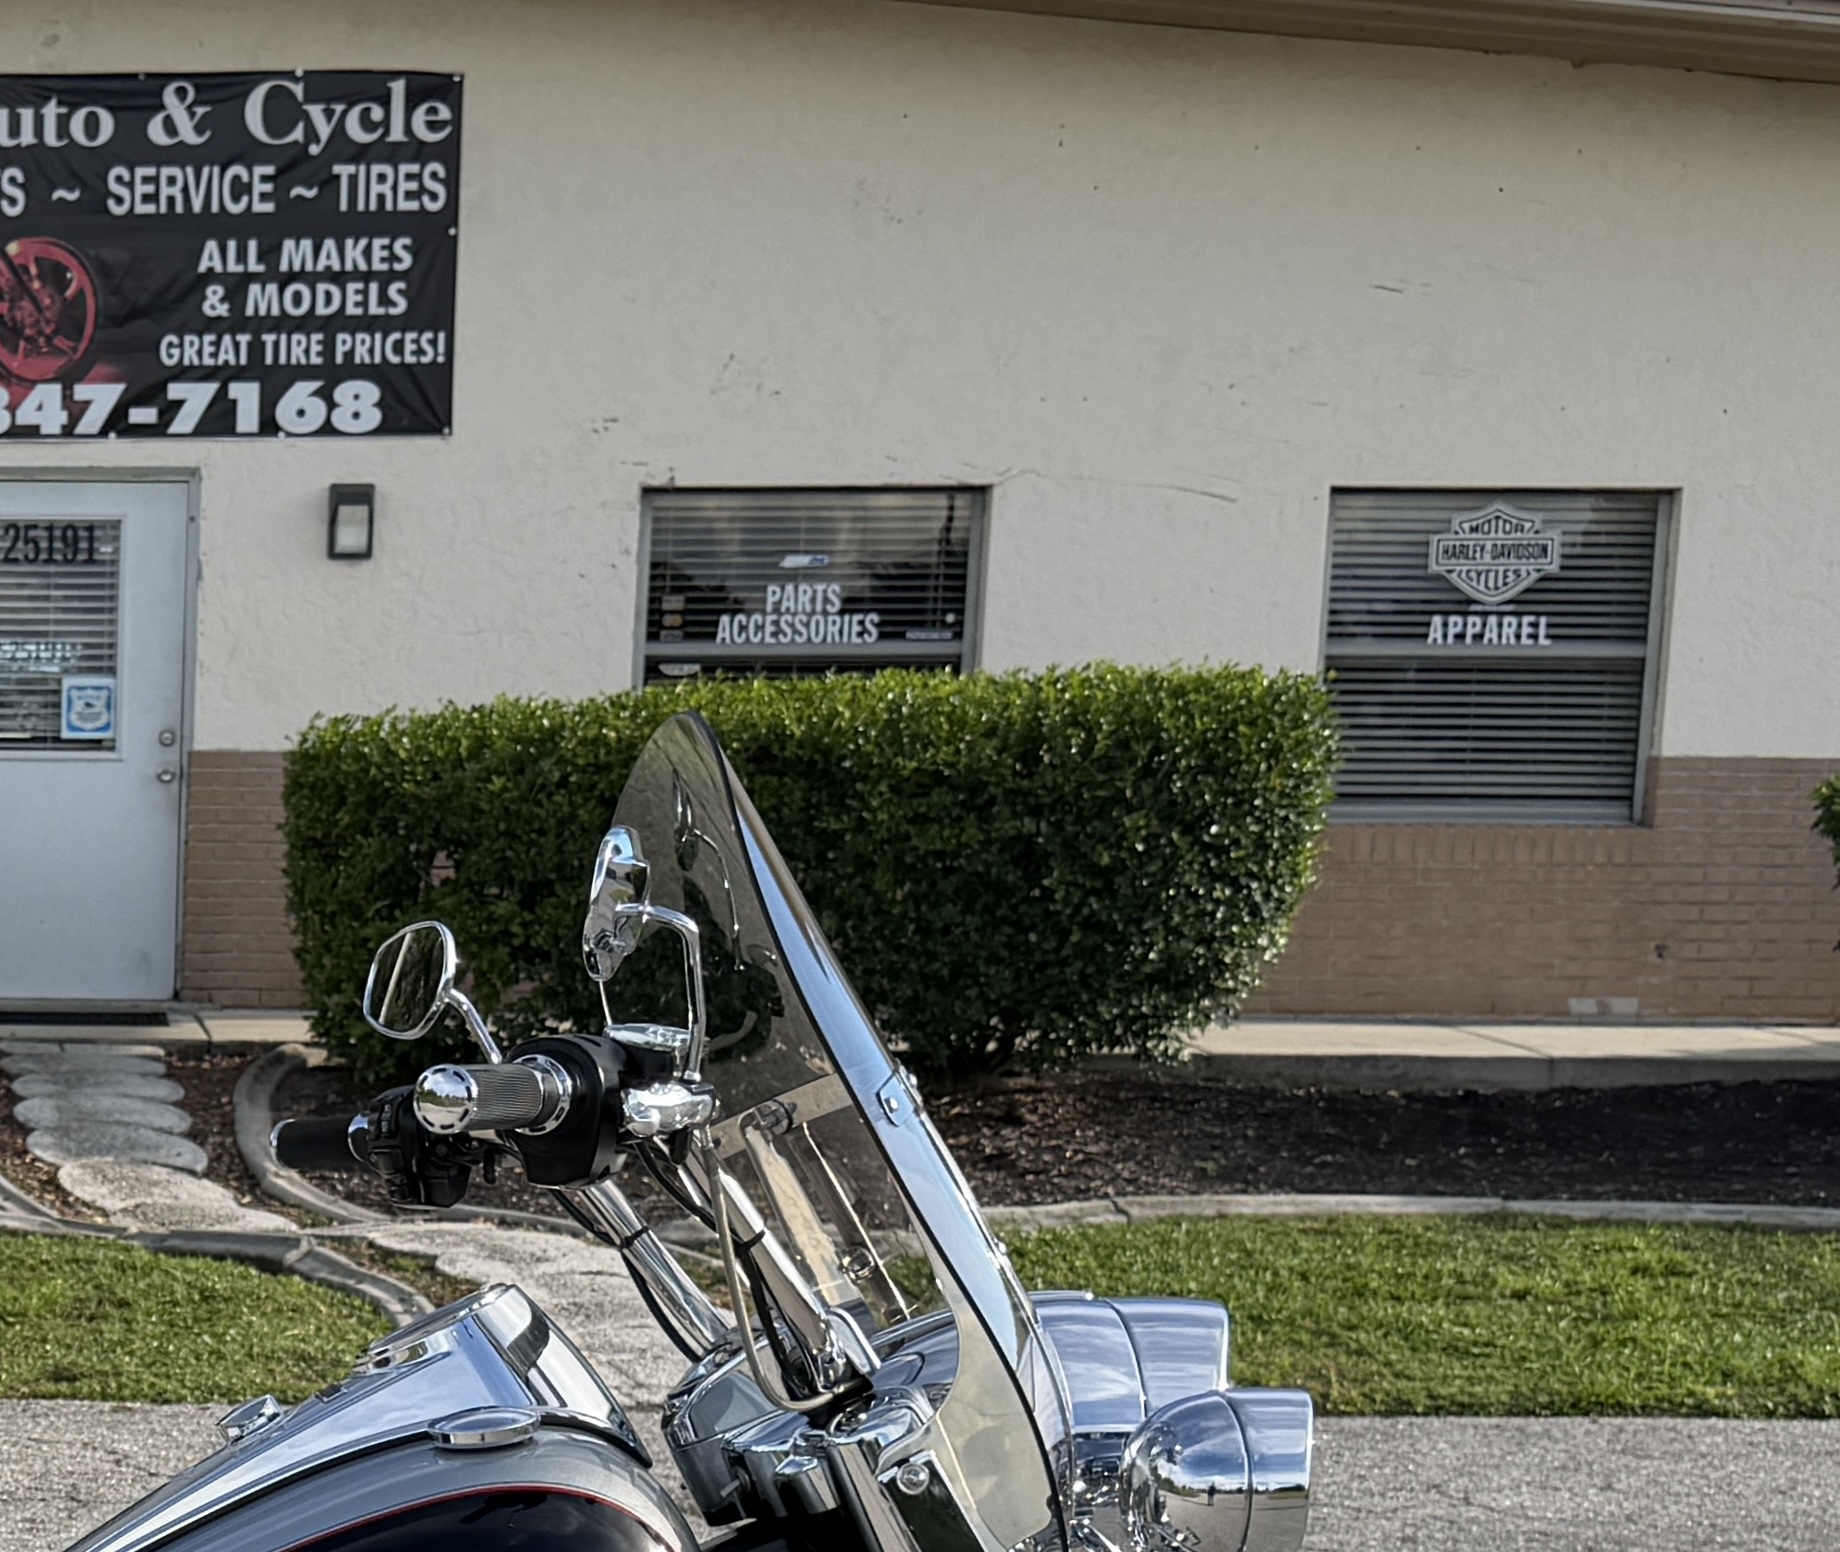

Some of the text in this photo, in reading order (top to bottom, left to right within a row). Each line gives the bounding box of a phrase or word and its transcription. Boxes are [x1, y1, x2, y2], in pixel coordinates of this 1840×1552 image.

[146, 81, 214, 146] &
[244, 79, 453, 156] Cycle
[106, 164, 277, 215] SERVICE
[332, 161, 447, 213] TIRES
[197, 237, 414, 273] ALL MAKES
[201, 281, 409, 318] & MODELS
[159, 331, 446, 367] GREAT TIRE PRICES!
[1468, 515, 1526, 535] MOTOR
[1, 522, 98, 564] 25191
[1441, 542, 1550, 561] HARLEY-DAVIDSON
[1465, 568, 1523, 592] CYCLES
[765, 582, 842, 614] PARTS
[715, 613, 881, 645] ACCESSORIES
[1426, 614, 1554, 646] APPAREL
